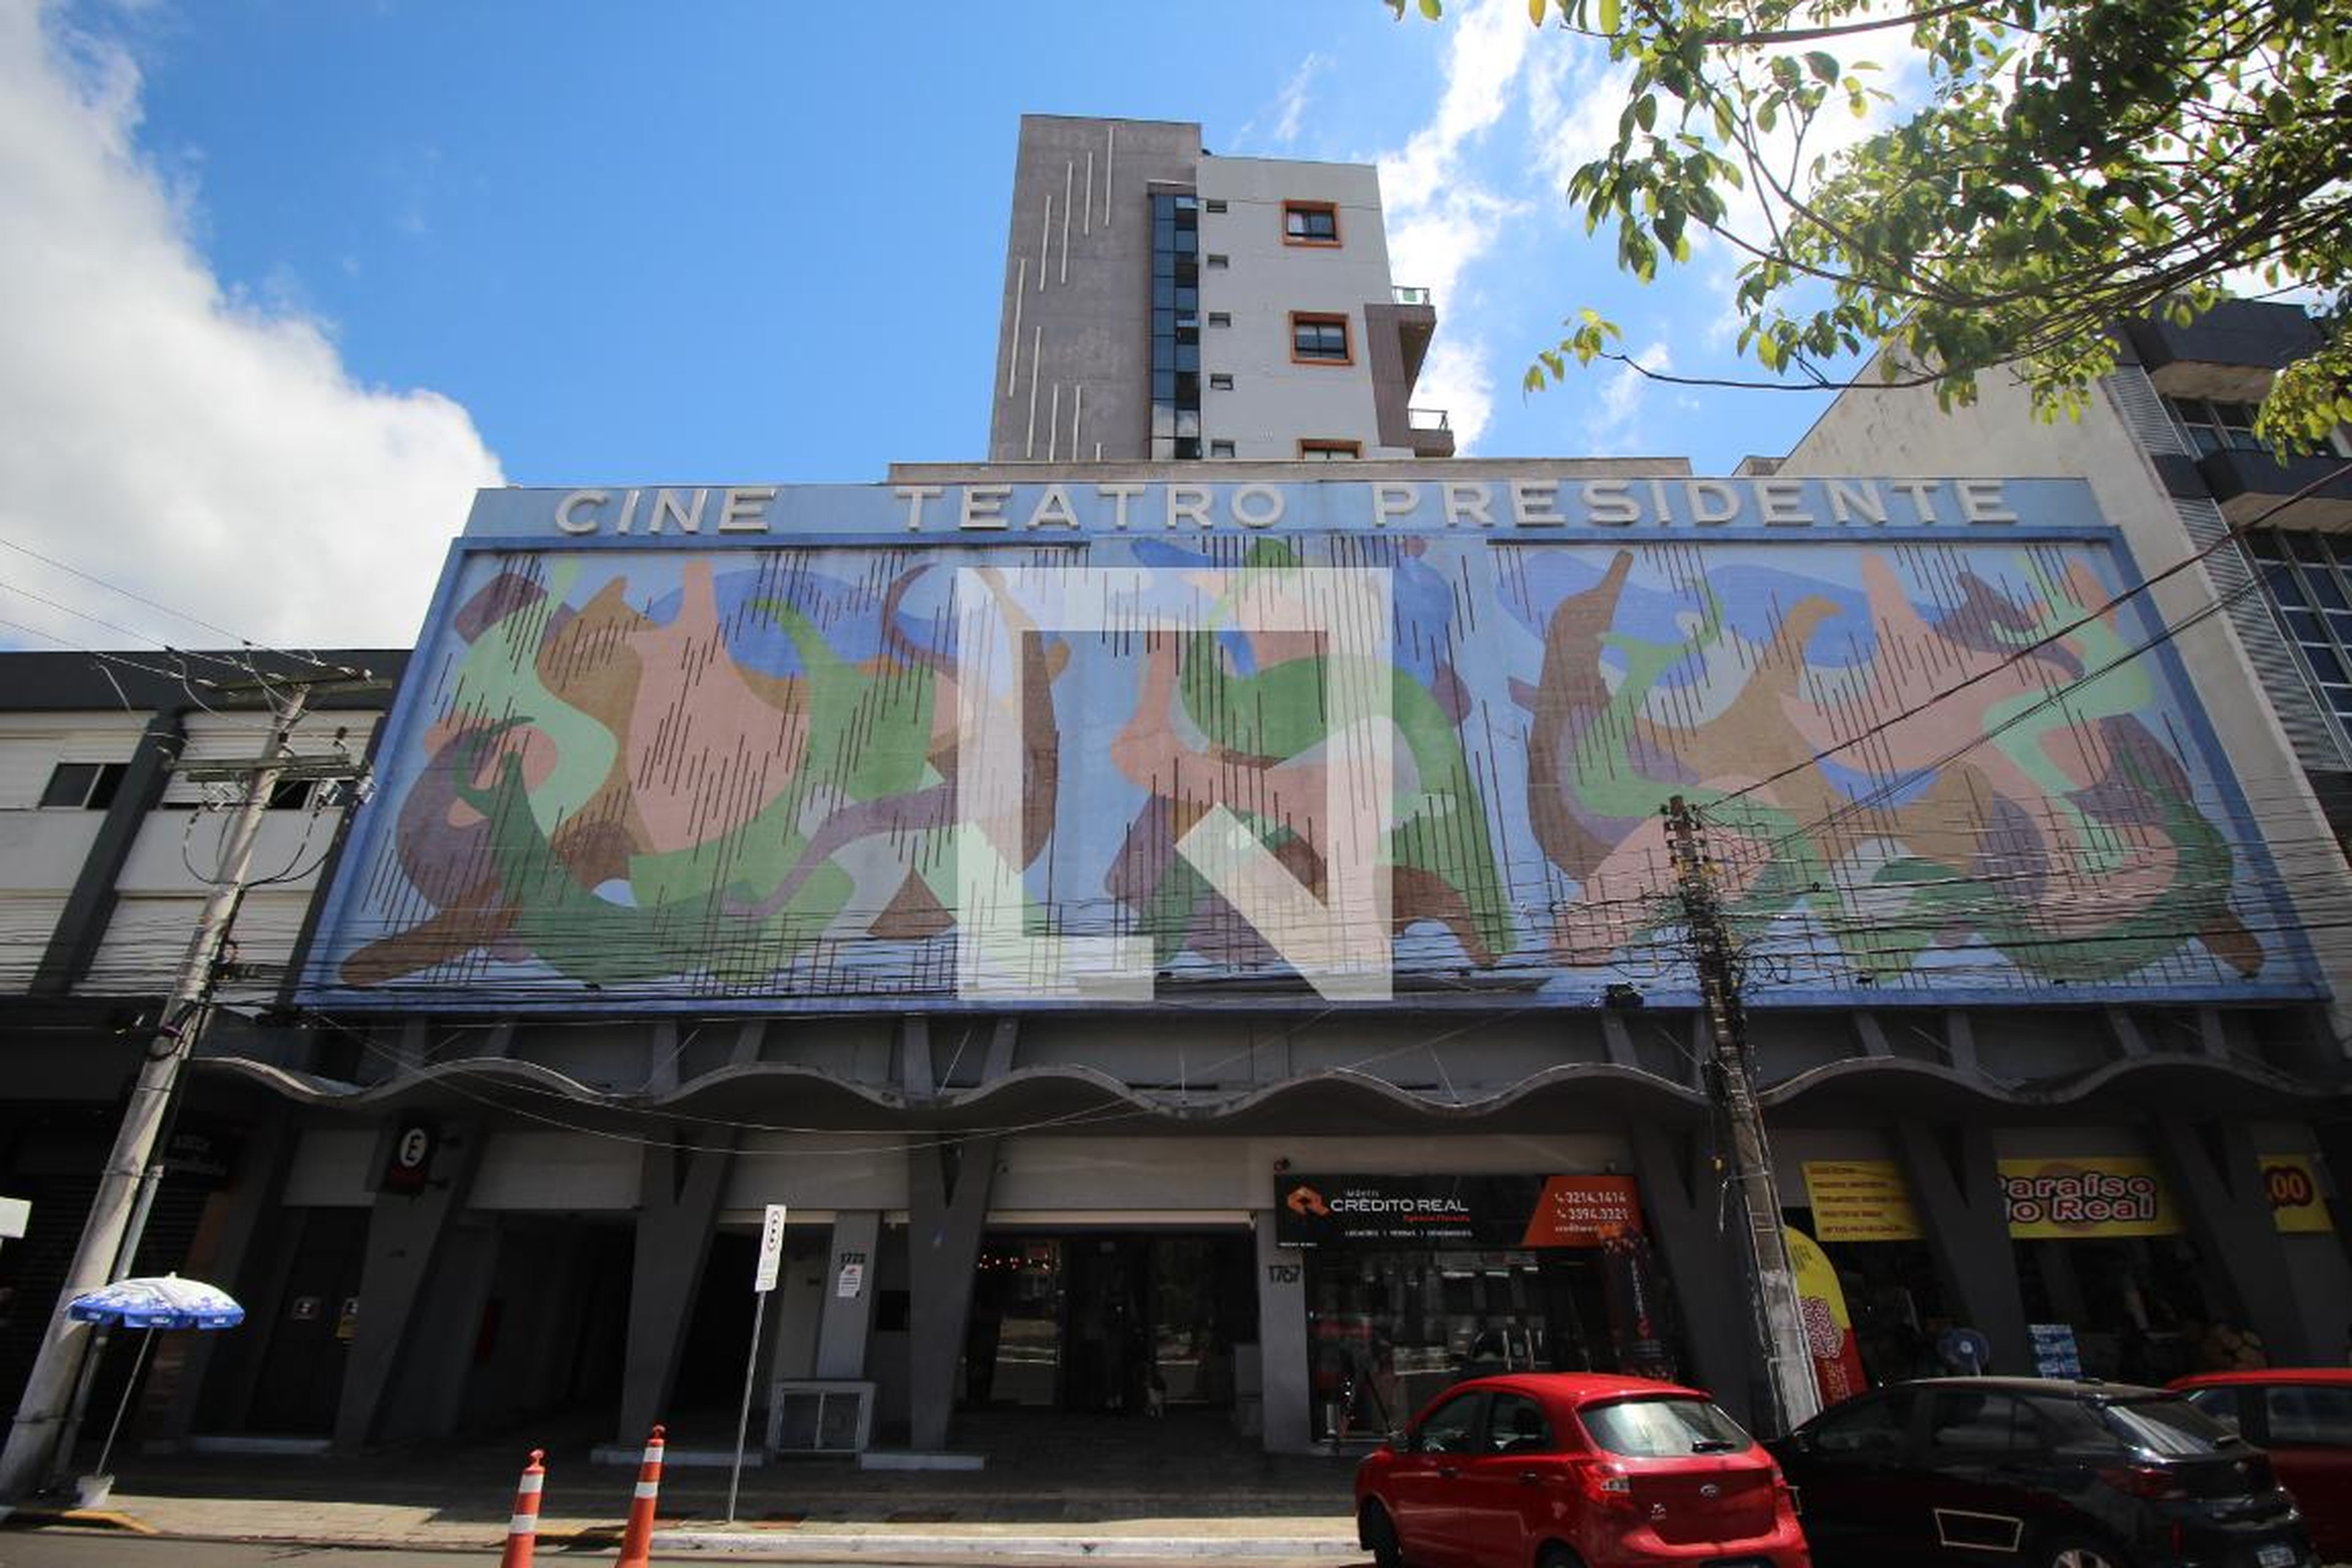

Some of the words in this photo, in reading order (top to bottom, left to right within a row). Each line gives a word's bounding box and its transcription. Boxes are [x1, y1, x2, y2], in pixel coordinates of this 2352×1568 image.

[555, 488, 775, 535] CINE
[894, 484, 1286, 532] TEATRO
[1371, 480, 2019, 528] PRESIDENTE
[1330, 1197, 1415, 1212] CRÉDITO
[1417, 1199, 1469, 1212] REAL
[2052, 1195, 2155, 1222] Real
